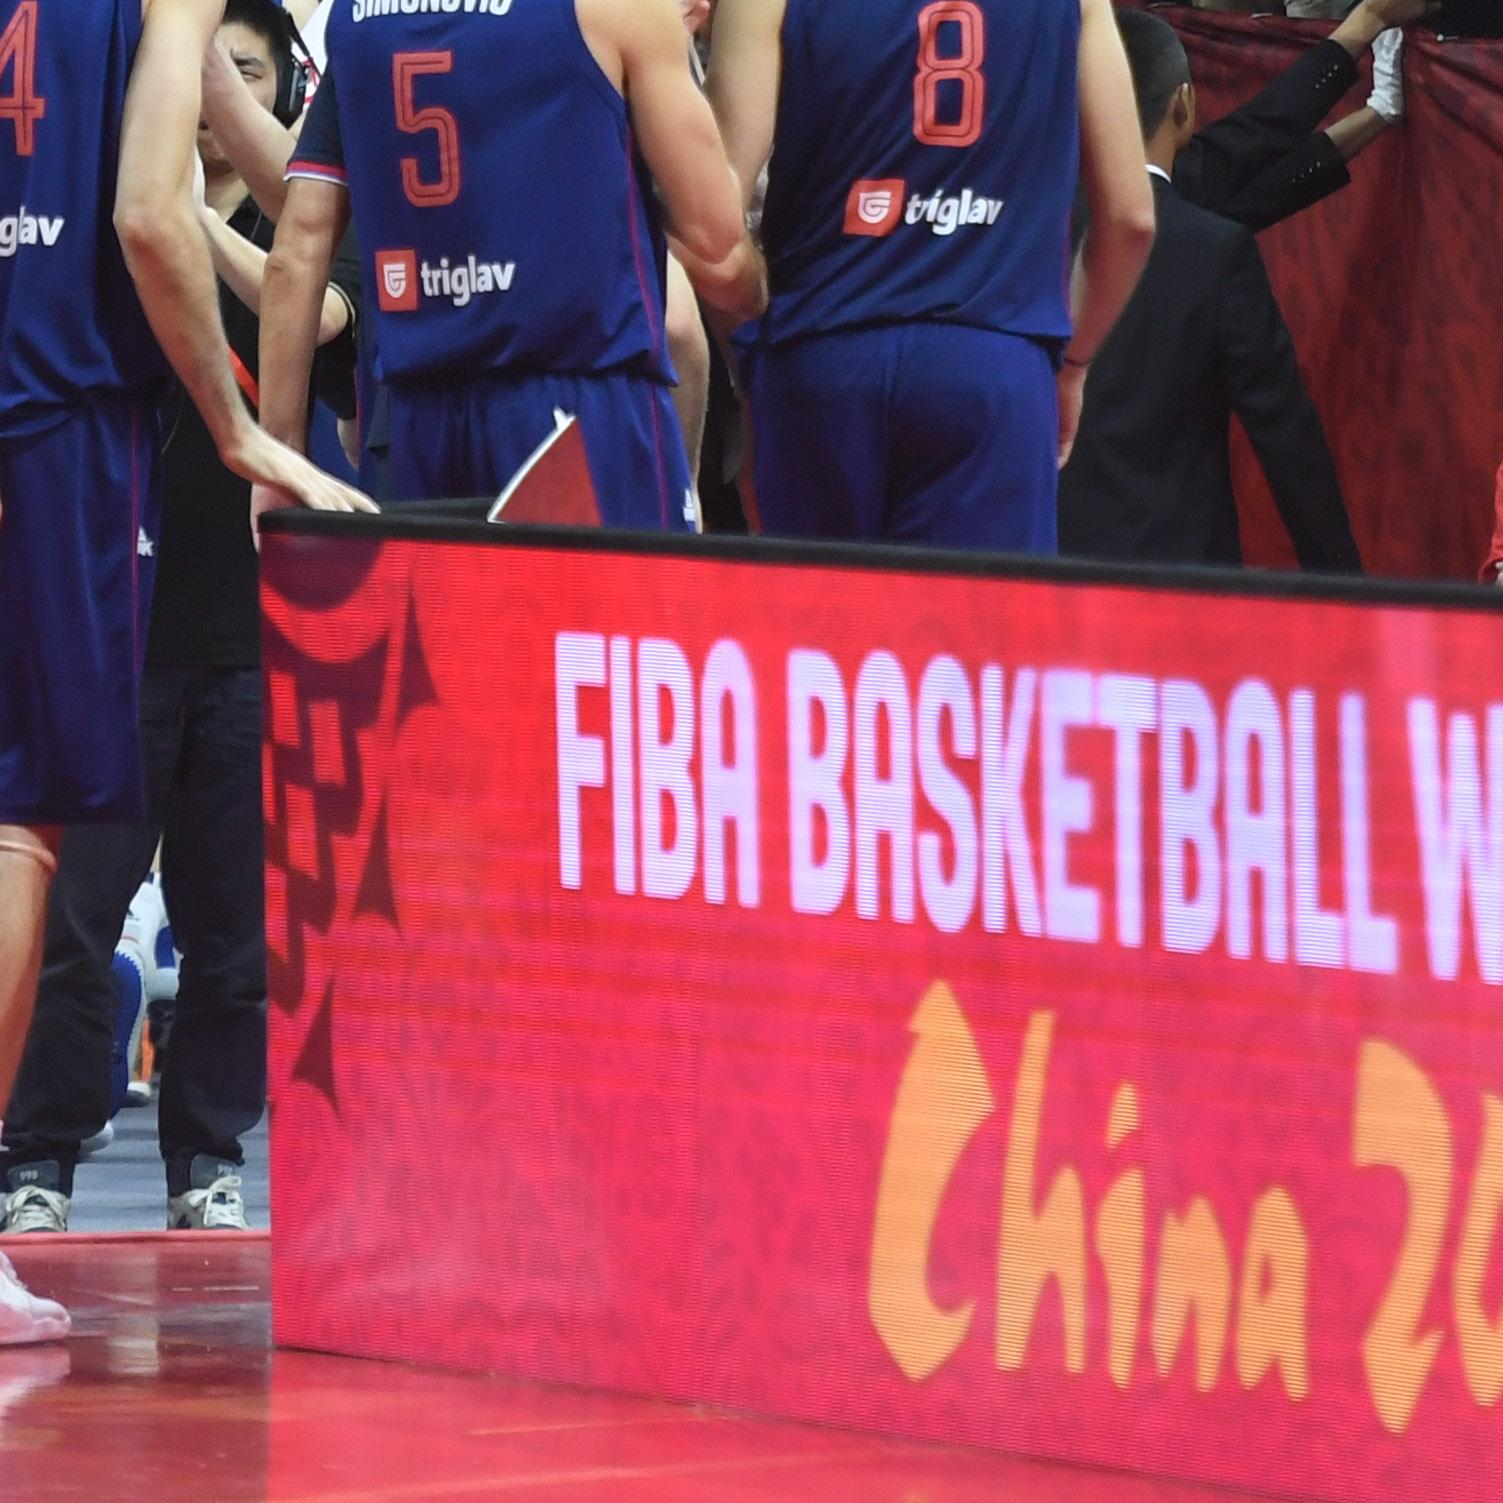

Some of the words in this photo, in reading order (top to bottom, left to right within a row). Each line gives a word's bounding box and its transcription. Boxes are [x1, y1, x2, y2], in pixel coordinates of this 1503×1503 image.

[392, 49, 462, 208] 5
[912, 0, 987, 148] 8
[420, 253, 517, 308] triglav
[904, 188, 1004, 236] triglav
[554, 630, 760, 909] FIBA
[786, 646, 1400, 976] BASKETBALL
[867, 978, 1311, 1402] China
